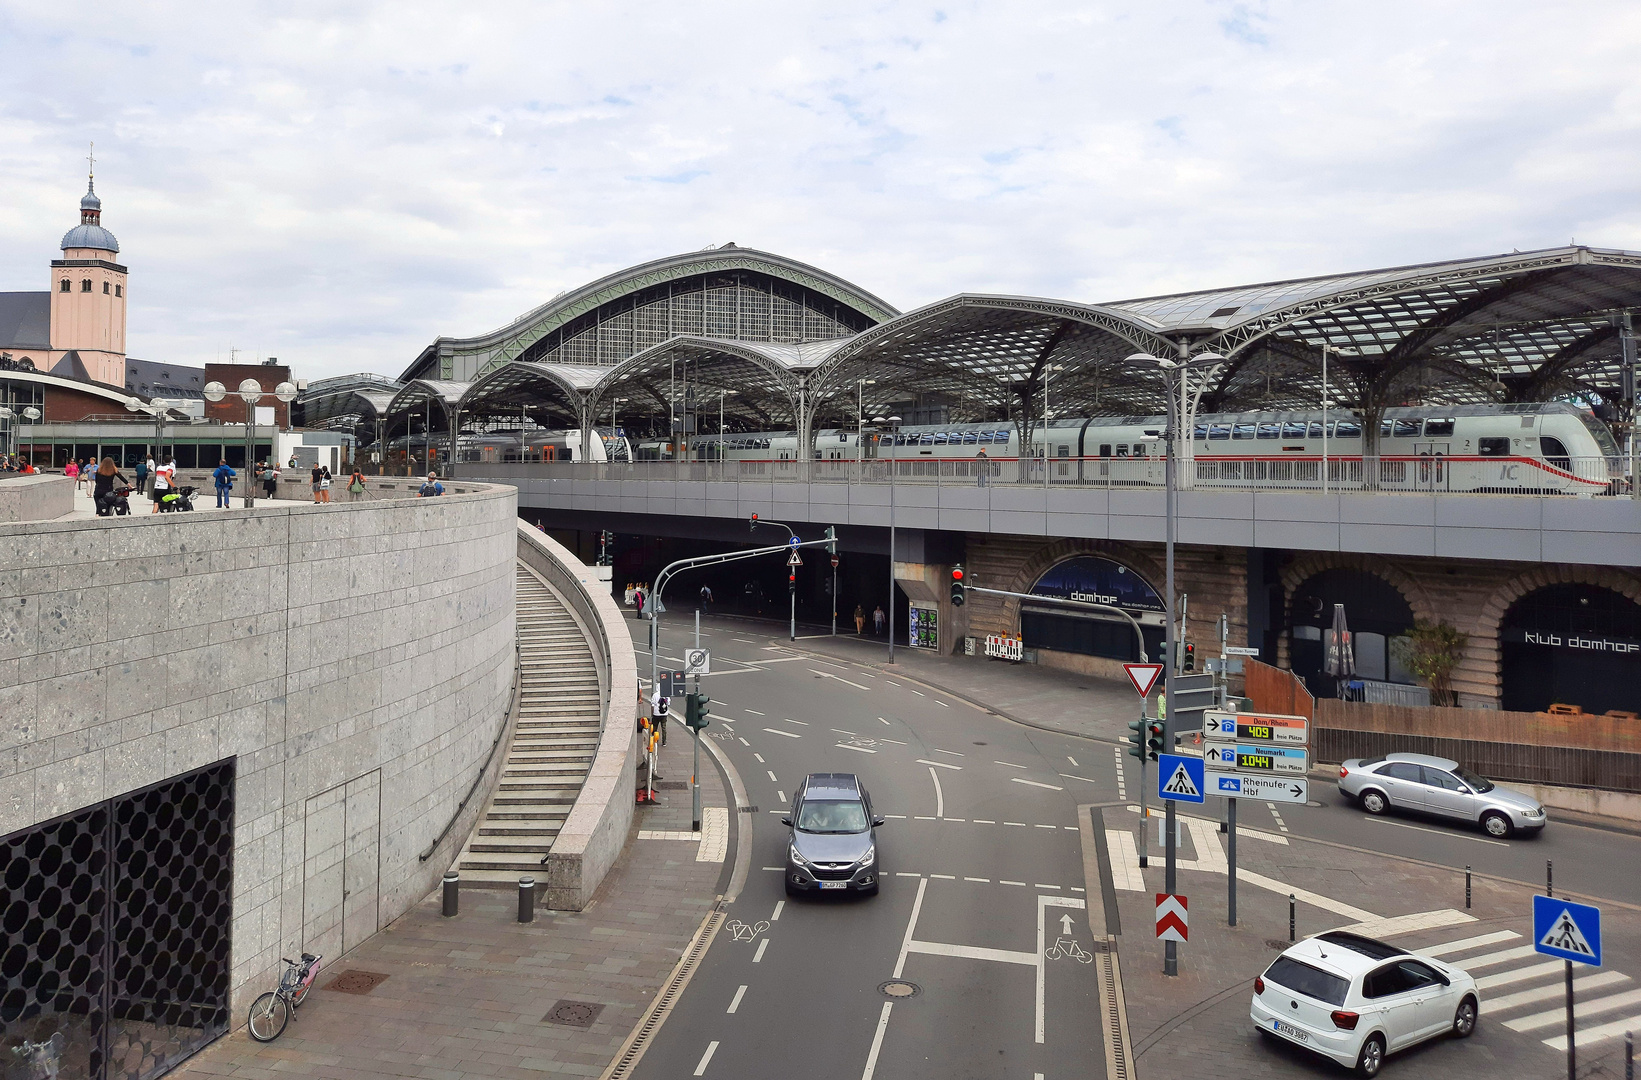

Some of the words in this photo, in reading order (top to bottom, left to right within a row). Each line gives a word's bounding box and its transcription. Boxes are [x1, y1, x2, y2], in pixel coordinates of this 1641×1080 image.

[1500, 464, 1519, 481] IC
[1070, 590, 1118, 604] domhof
[1525, 631, 1561, 646] klub
[1568, 636, 1640, 653] domhof
[692, 655, 702, 663] 30
[1253, 718, 1289, 727] Dom/Rhein
[1248, 726, 1269, 738] 409
[1255, 748, 1286, 757] Neumarkt
[1241, 755, 1269, 768] 1044
[1243, 777, 1287, 789] Rheinufer
[1243, 787, 1259, 796] Hbf
